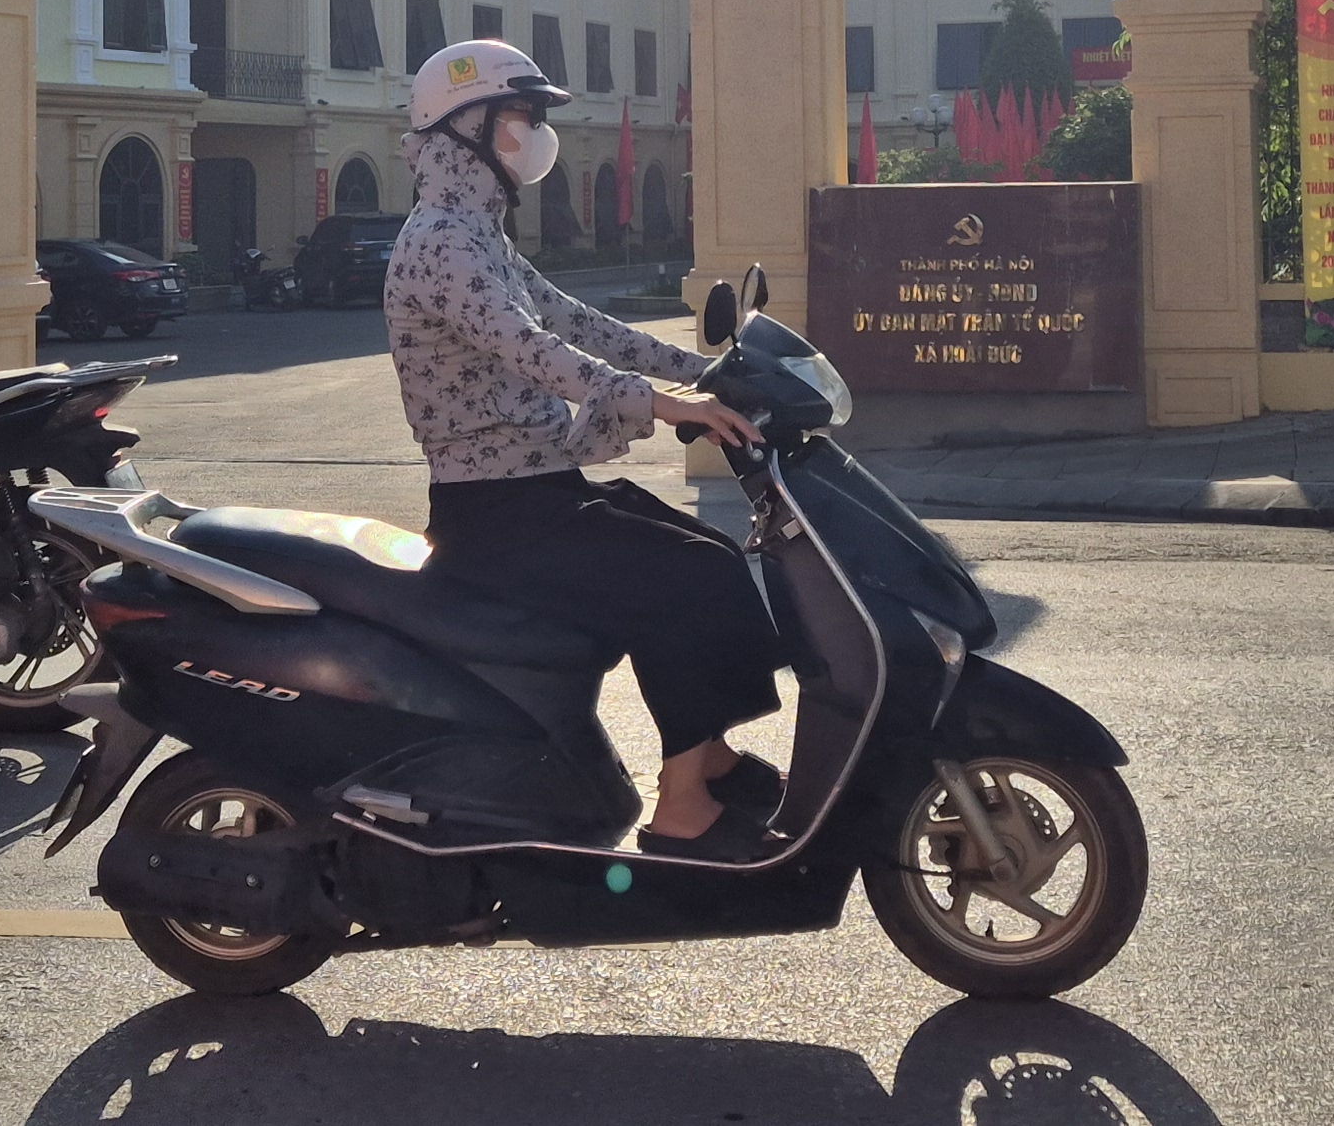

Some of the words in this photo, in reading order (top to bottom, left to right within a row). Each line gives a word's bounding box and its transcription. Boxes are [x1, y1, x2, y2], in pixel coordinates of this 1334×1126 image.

[1309, 132, 1327, 149] ĐẠI
[900, 256, 947, 271] THÀNH
[950, 252, 980, 271] PHỐ
[984, 255, 1004, 271] HÀ
[1008, 255, 1035, 274] NỘI
[899, 276, 947, 303] ĐẢNG
[951, 276, 974, 303] ỦY
[853, 307, 874, 332] ỦY
[880, 313, 916, 331] BAN
[920, 310, 957, 335] MẶT
[962, 308, 1005, 336] TRẬN
[1011, 306, 1035, 332] TỔ
[1037, 306, 1085, 334] QUỐC
[914, 341, 938, 363] XÃ
[942, 339, 983, 363] HOÀI
[987, 339, 1023, 364] ĐỨC
[173, 660, 300, 702] LEAD
